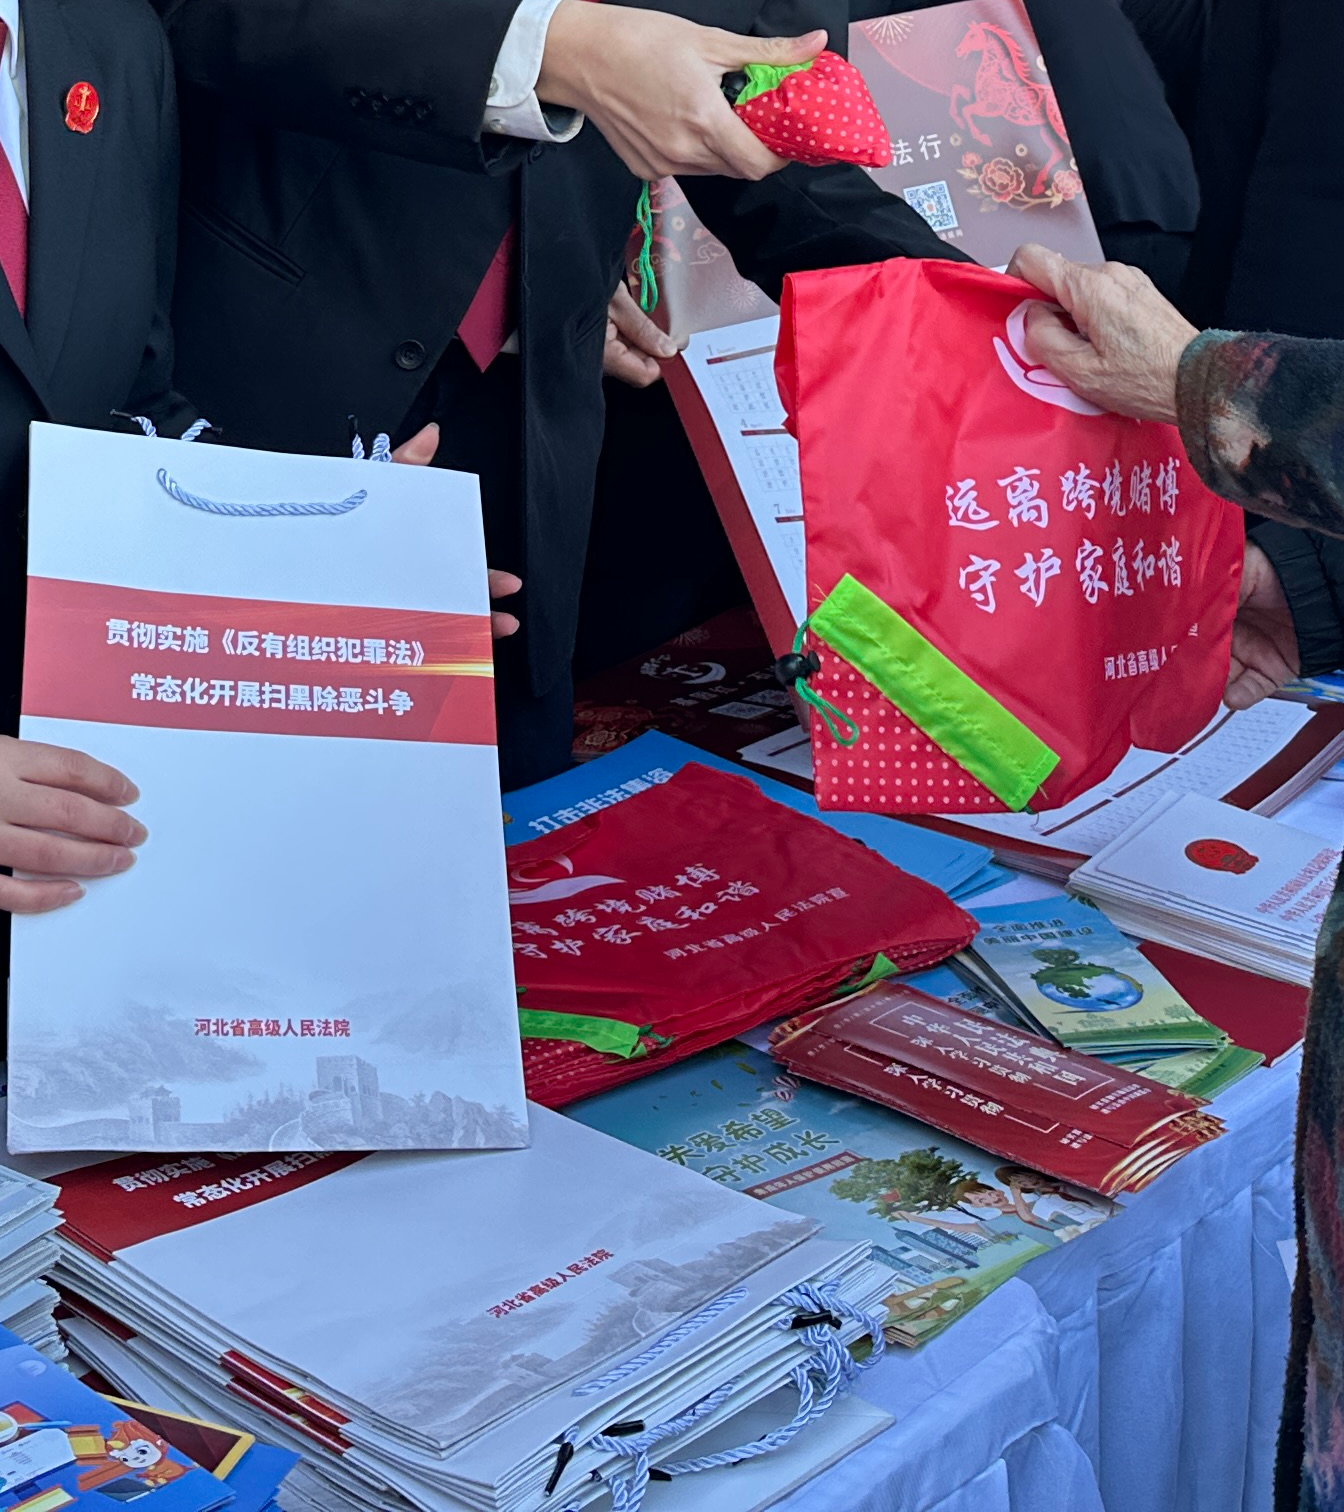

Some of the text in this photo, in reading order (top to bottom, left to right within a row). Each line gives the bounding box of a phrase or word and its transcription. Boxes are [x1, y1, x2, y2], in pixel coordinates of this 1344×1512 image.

[945, 456, 1182, 533] 远离跨境赌博
[958, 535, 1184, 616] 守护家庭和谐
[105, 618, 426, 668] 贯彻实施《反有组织犯罪法》
[129, 671, 415, 717] 常态化开展扫黑除恶斗争
[512, 862, 722, 937] 离跨境赌博
[662, 885, 851, 961] 河北省高级人民法院宣
[992, 918, 1067, 934] 全面推进
[982, 925, 1095, 946] 美丽中国建设
[193, 1016, 352, 1041] 河北省高级人民法院
[901, 1013, 1088, 1087] 中华人民共和国
[952, 1017, 1069, 1062] 民法典
[657, 1107, 801, 1167] 关爱希望
[703, 1129, 841, 1183] 守护成长
[487, 1247, 615, 1320] 河北省高级人民法院
